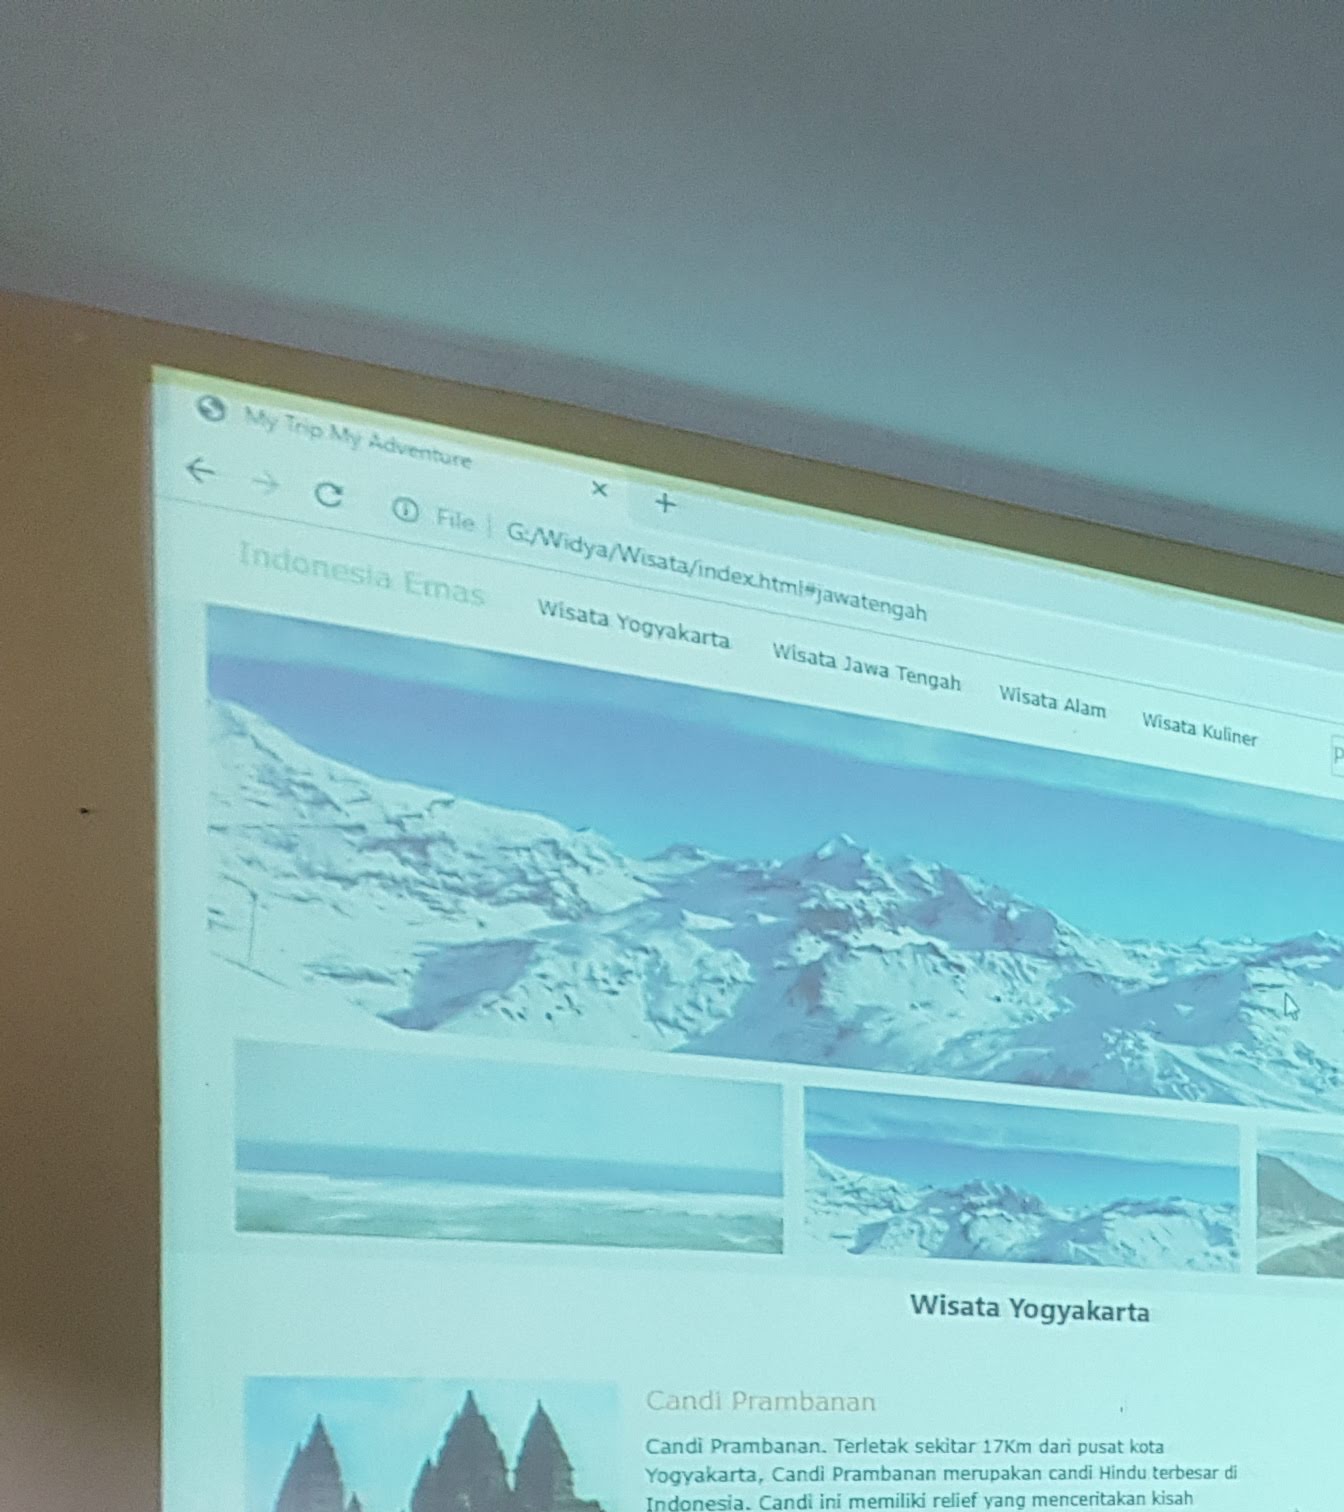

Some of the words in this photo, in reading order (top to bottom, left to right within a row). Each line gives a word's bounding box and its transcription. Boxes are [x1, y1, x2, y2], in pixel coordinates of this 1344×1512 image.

[245, 405, 278, 432] My
[286, 413, 323, 439] Trip
[330, 424, 362, 450] My
[368, 433, 473, 469] Adventure
[436, 508, 475, 533] File
[239, 540, 392, 590] Indonesia
[405, 571, 487, 606] Emas
[538, 598, 609, 628] Wisata
[618, 613, 731, 650] Yogyakarta
[774, 642, 837, 670] Wisata
[843, 656, 890, 680] Jawa
[897, 666, 961, 693] Tengah
[1000, 685, 1058, 710] Wisata
[1064, 698, 1106, 719] Alam
[1143, 712, 1197, 736] Wisata
[1203, 725, 1258, 748] Kuliner
[911, 1293, 1000, 1319] Wisata
[1010, 1298, 1150, 1326] Yogyakarta
[647, 1389, 721, 1412] Candi
[733, 1390, 876, 1413] Prambanan
[646, 1437, 702, 1454] Candi
[711, 1437, 826, 1454] Prambanan.
[834, 1437, 907, 1454] Terletak
[915, 1438, 975, 1454] sekitar
[983, 1439, 1032, 1454] 17Km
[1039, 1437, 1071, 1454] dari
[1079, 1440, 1123, 1458] pusat
[1130, 1438, 1164, 1454] kota
[646, 1466, 764, 1487] Yogyakarta,
[772, 1465, 825, 1483] Candi
[833, 1465, 936, 1482] Prambanan
[943, 1465, 1042, 1485] merupakan
[1048, 1464, 1092, 1481] candi
[1100, 1464, 1146, 1481] Hindu
[1152, 1464, 1219, 1481] terbesar
[1225, 1464, 1237, 1480] di
[759, 1492, 812, 1511] Candi
[820, 1491, 841, 1510] ini
[849, 1490, 926, 1511] memiliki
[932, 1490, 977, 1509] relief
[984, 1493, 1025, 1511] yang
[1032, 1490, 1145, 1508] menceritakan
[1151, 1489, 1193, 1507] kisah
